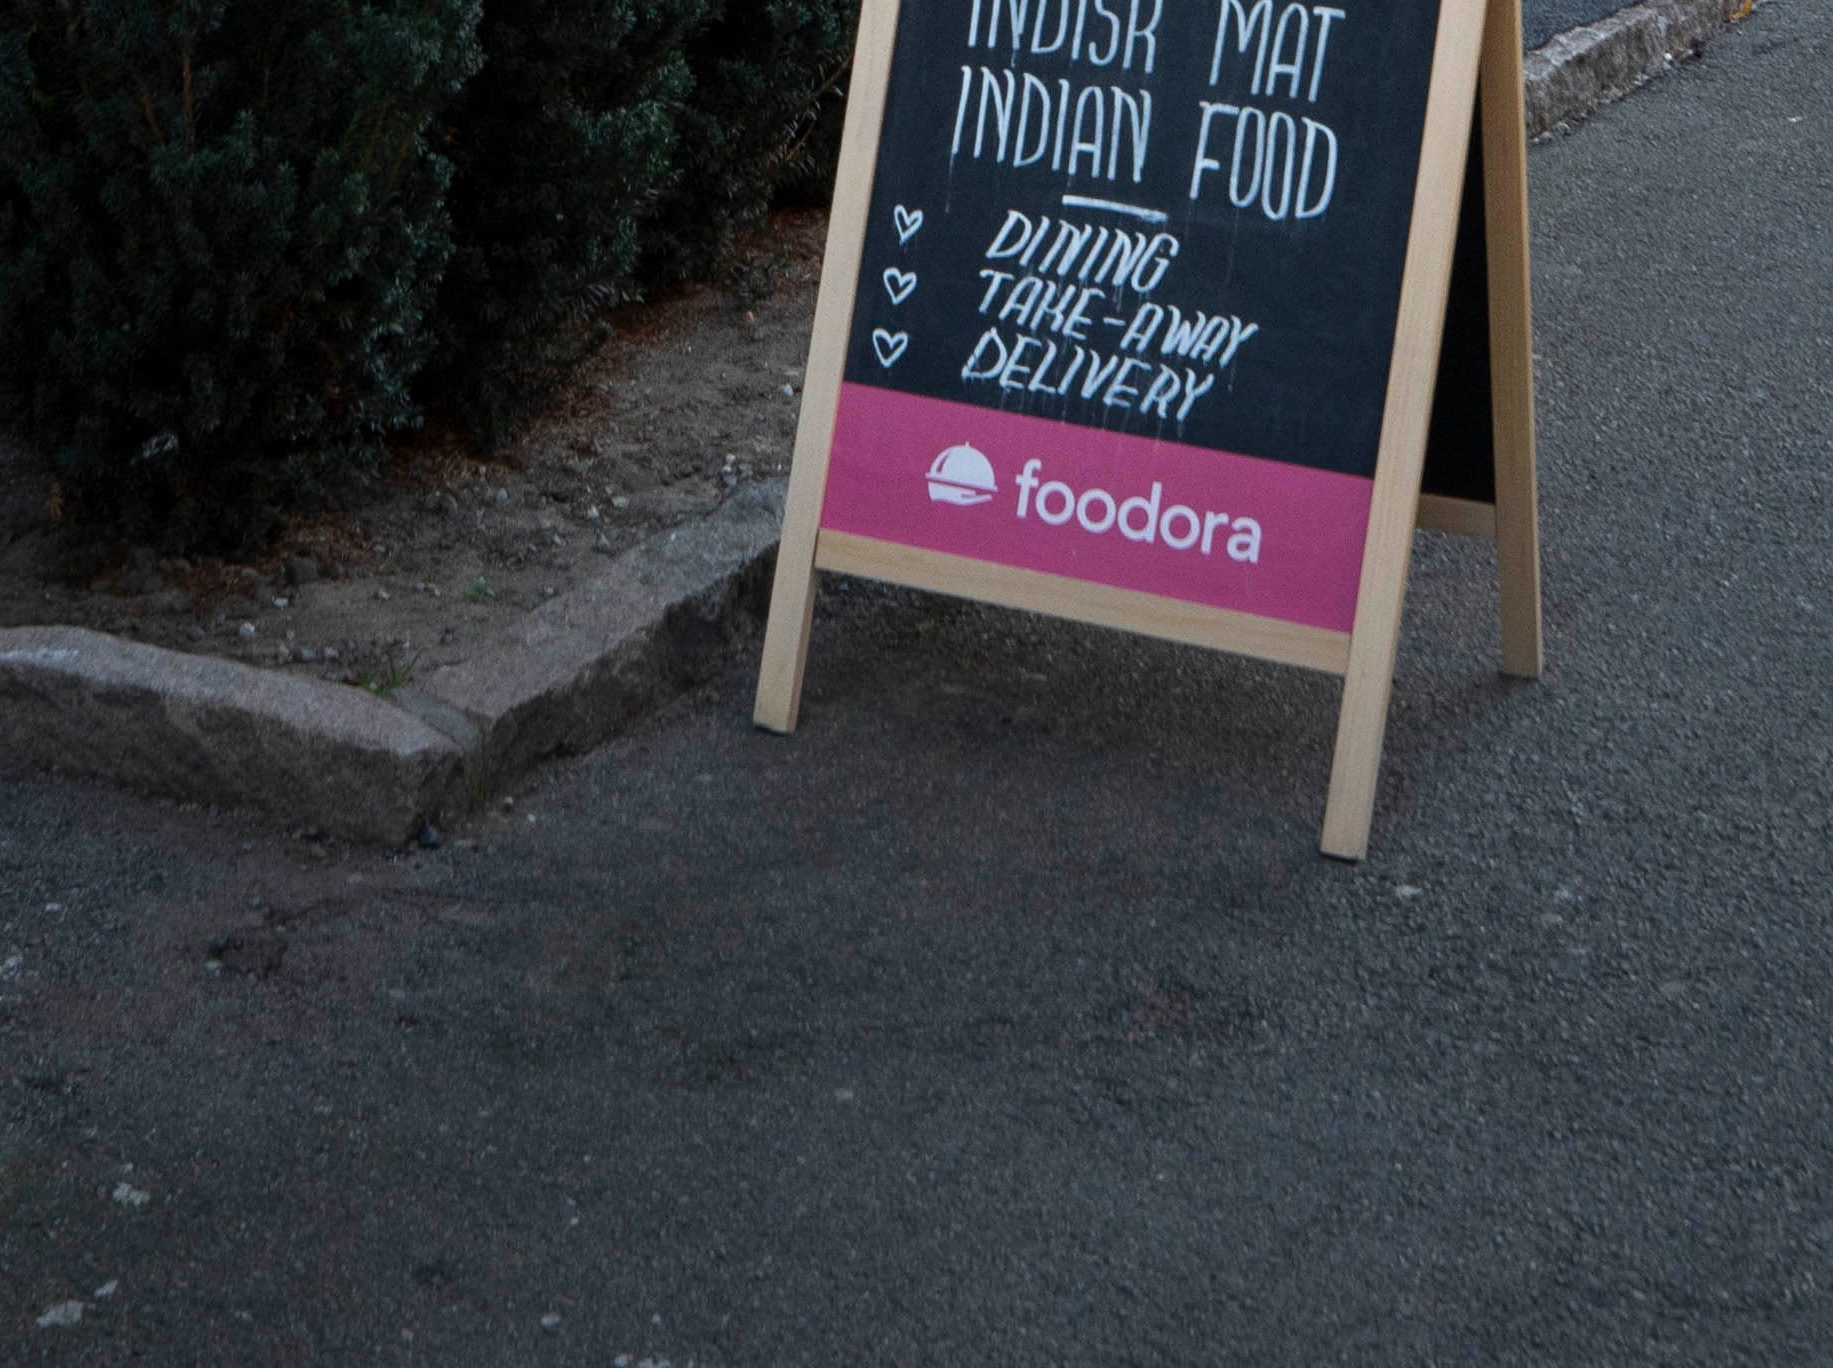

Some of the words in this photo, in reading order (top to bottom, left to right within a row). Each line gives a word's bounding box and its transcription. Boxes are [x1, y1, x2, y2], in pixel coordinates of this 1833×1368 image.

[950, 64, 1152, 184] INDIAN
[1188, 100, 1339, 222] FOOD
[984, 208, 1180, 294] DINING
[978, 267, 1260, 370] TAKE-AWAY
[960, 326, 1215, 422] DELIVERY
[1014, 458, 1263, 565] foodora
